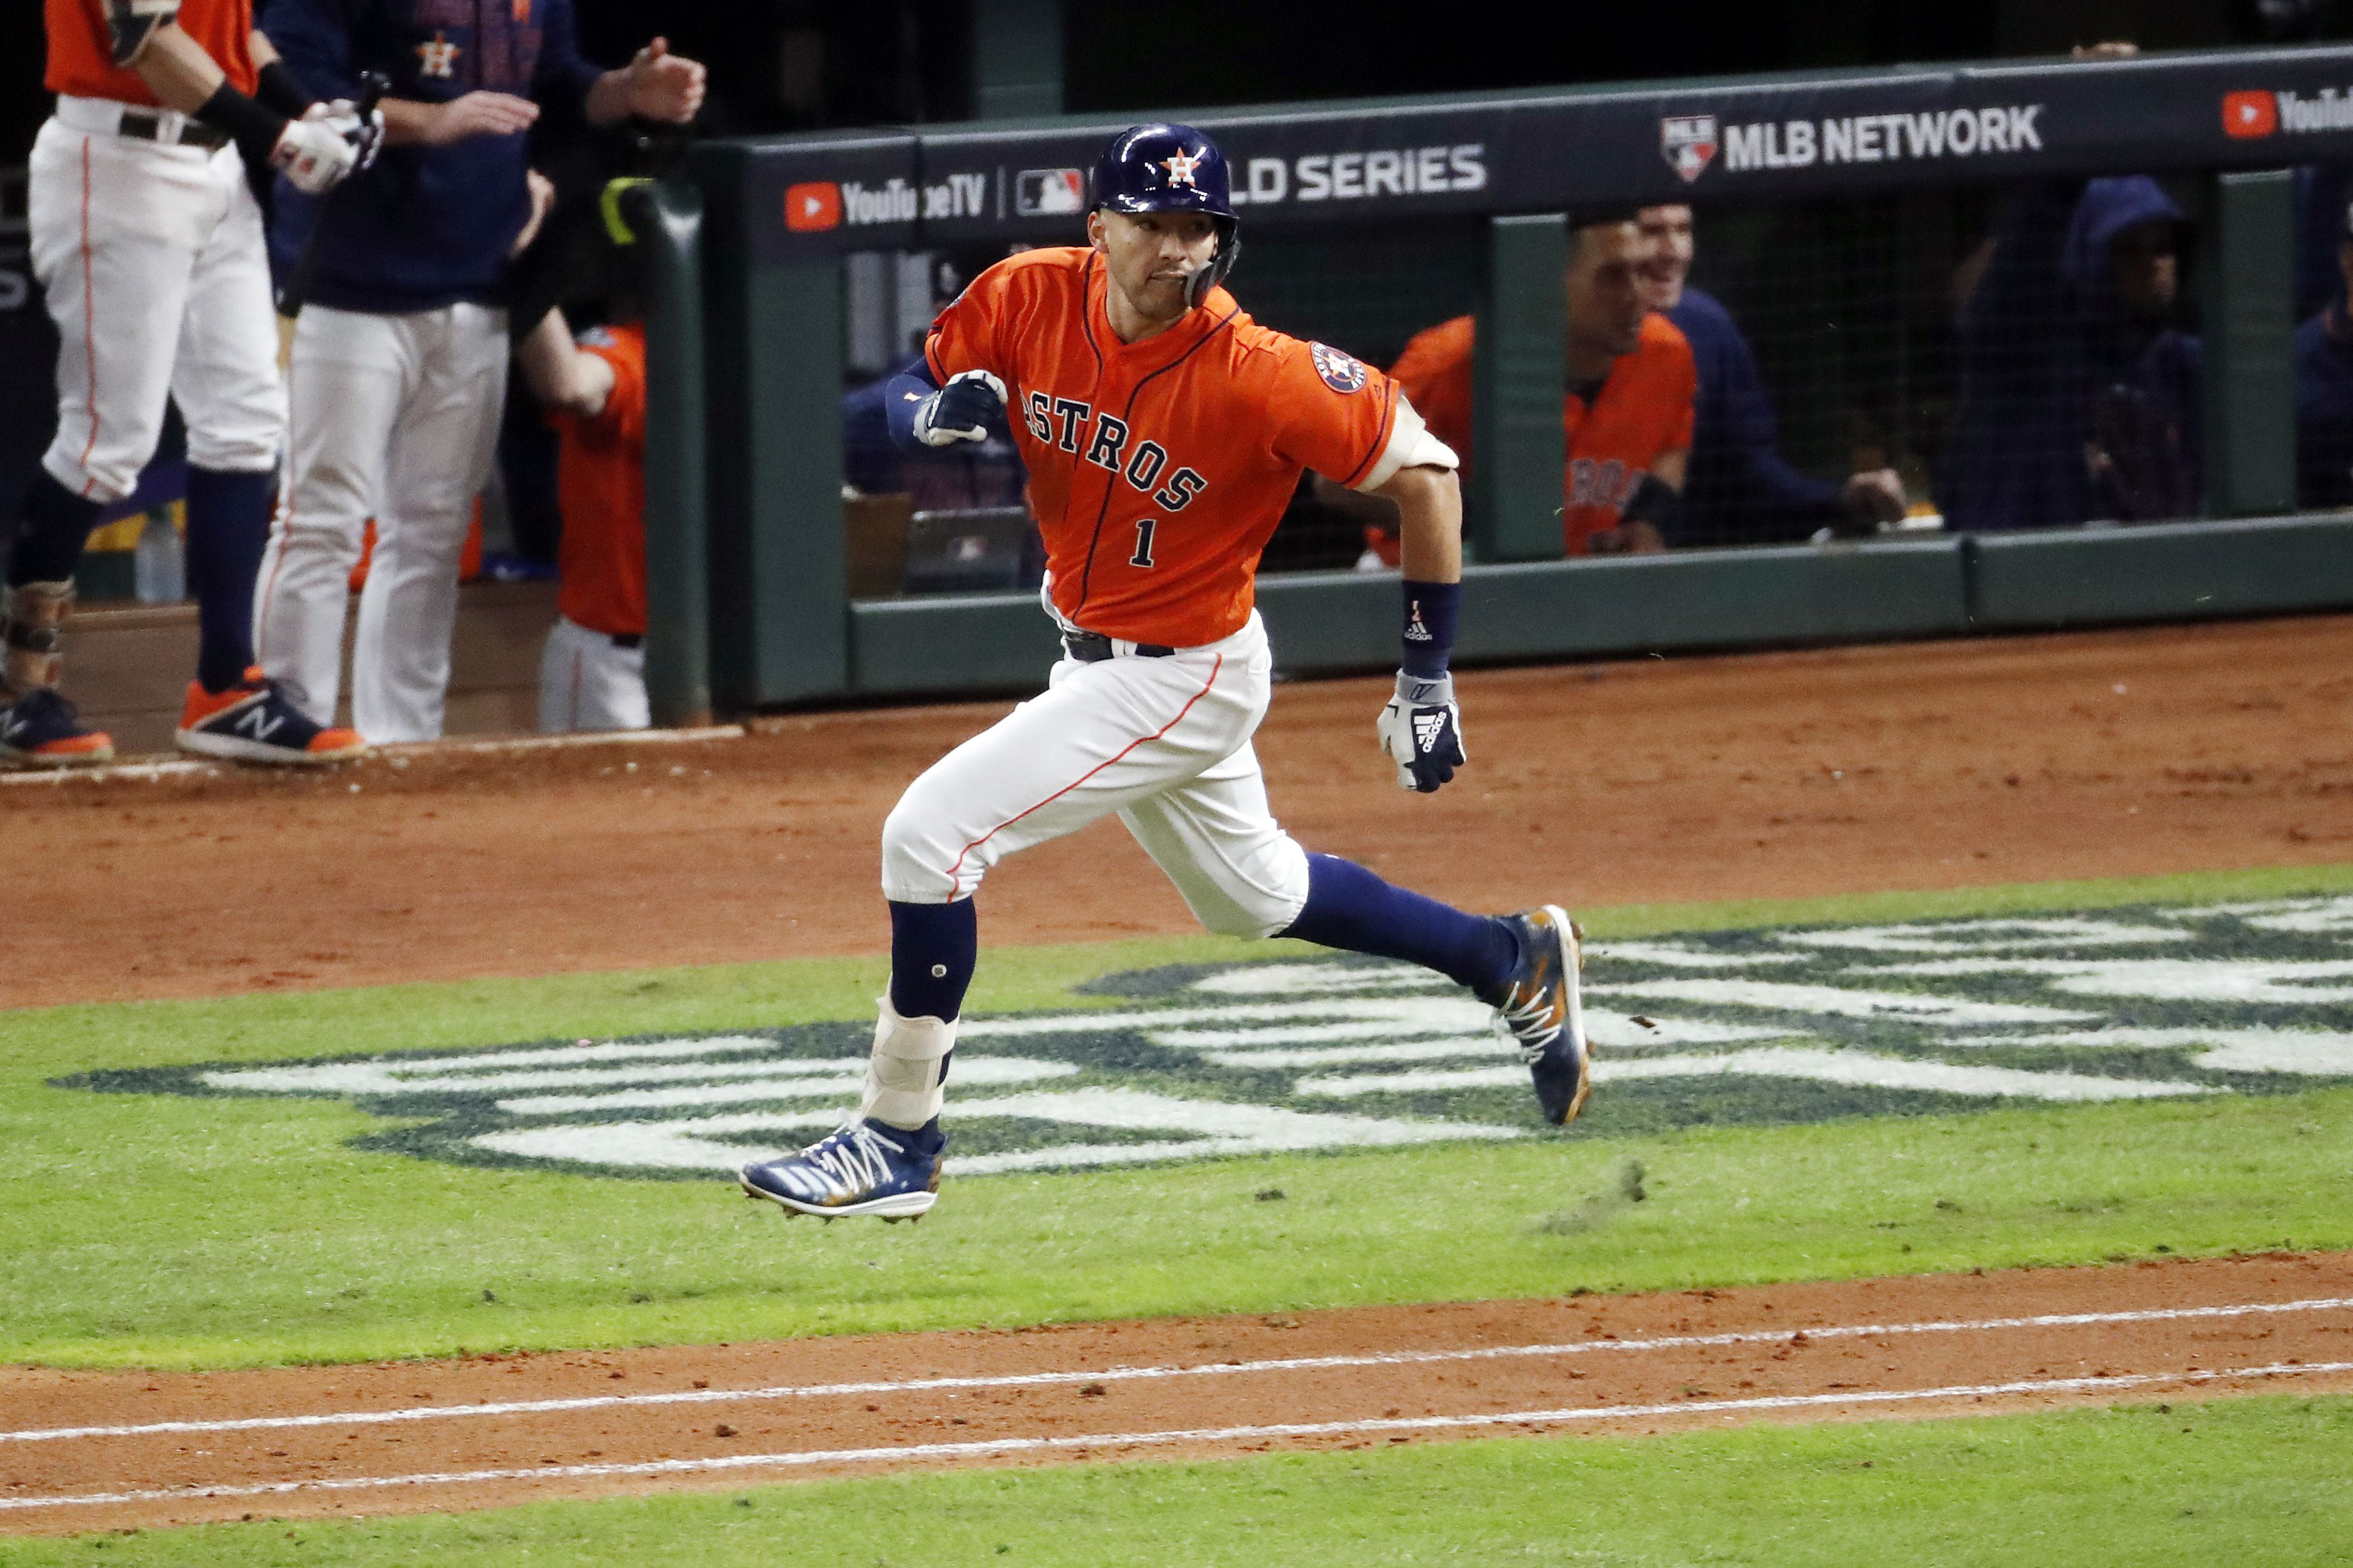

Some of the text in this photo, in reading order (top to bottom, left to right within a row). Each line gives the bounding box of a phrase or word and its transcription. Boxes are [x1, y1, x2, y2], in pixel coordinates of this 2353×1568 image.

[2277, 84, 2353, 134] YouTu
[1725, 104, 2042, 173] MLB NETWORK
[1294, 142, 1487, 202] SERIES
[1129, 519, 1157, 568] 1
